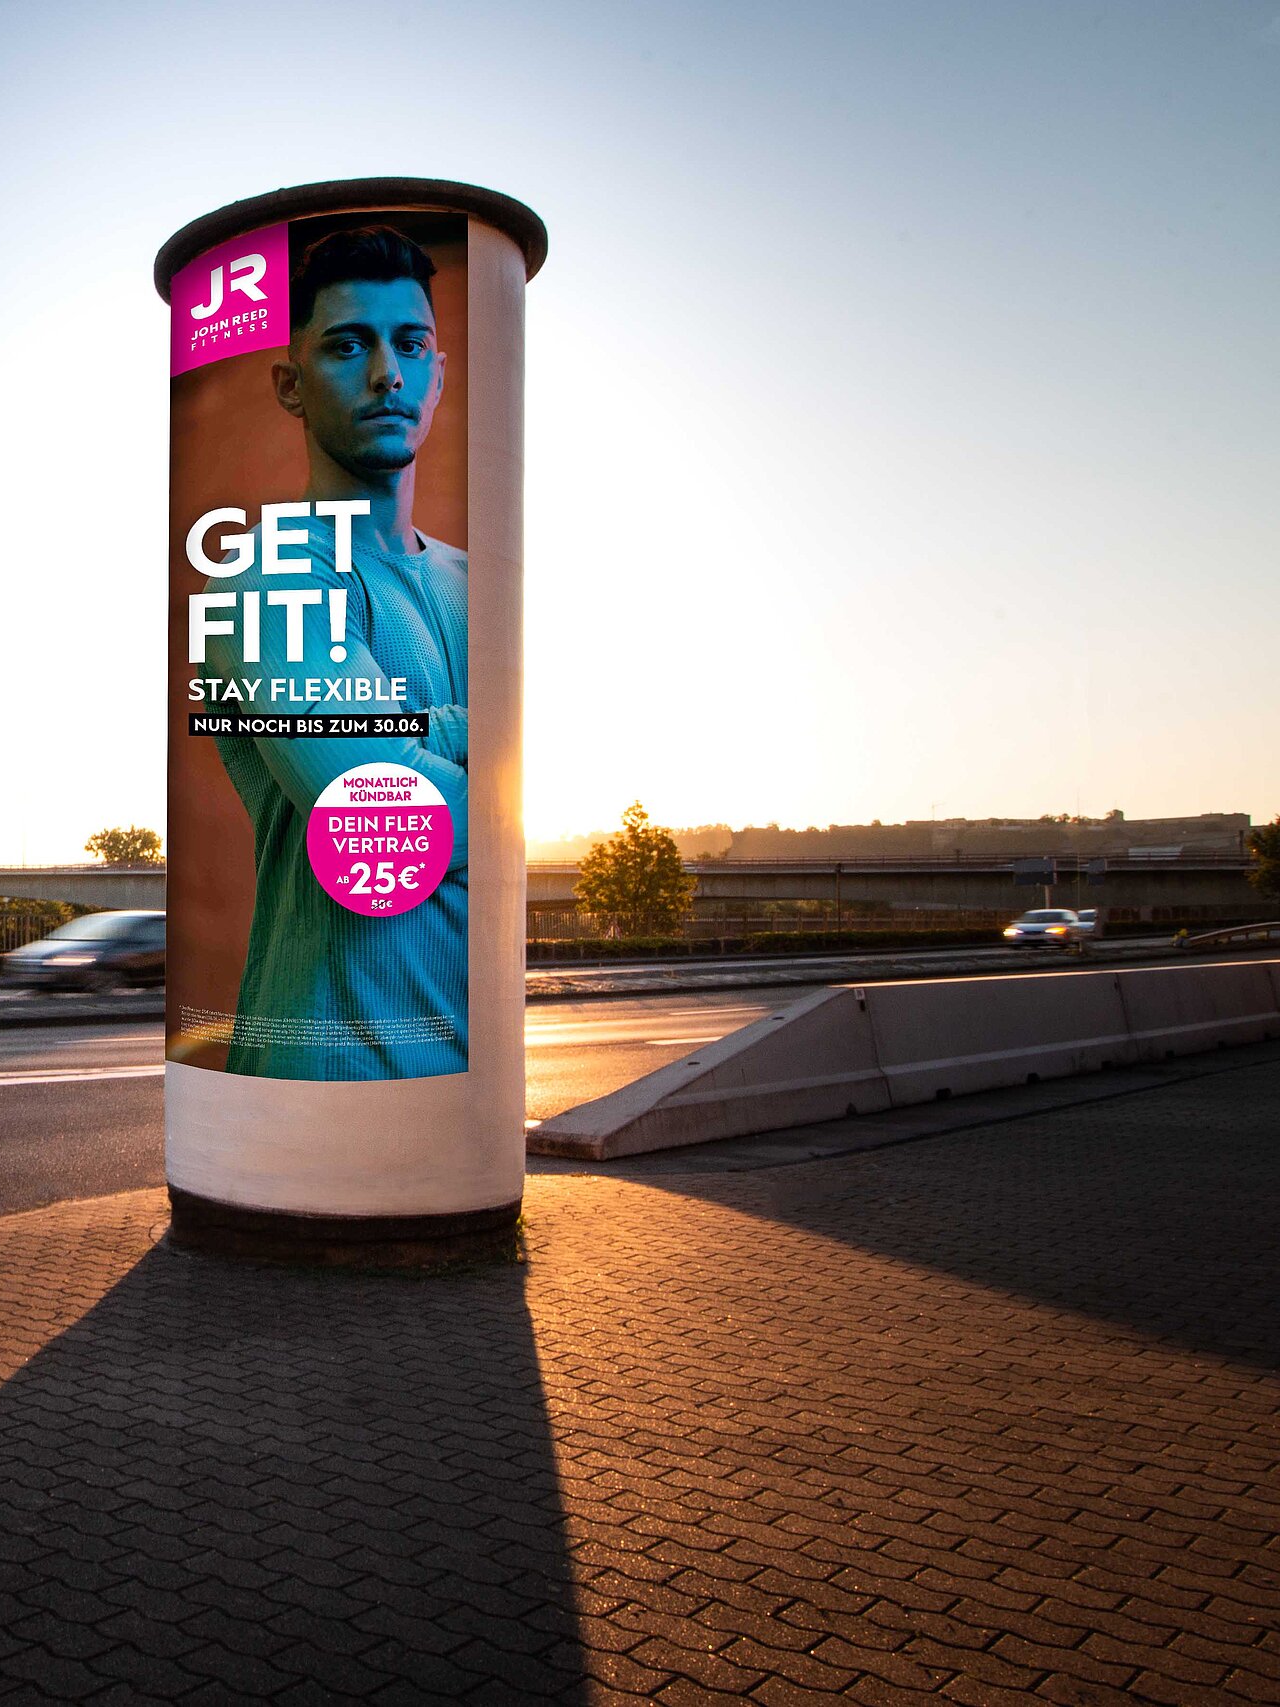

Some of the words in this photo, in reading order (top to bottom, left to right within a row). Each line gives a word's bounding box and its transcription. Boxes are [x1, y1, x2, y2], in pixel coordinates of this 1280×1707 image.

[191, 319, 228, 341] JOHN
[232, 309, 268, 326] REED
[186, 500, 370, 578] GET
[189, 589, 347, 663] FIT!
[188, 678, 262, 701] STAY
[270, 678, 407, 702] FLEXIBLE
[194, 719, 232, 732] NUR
[239, 719, 291, 732] NOCH
[296, 720, 323, 732] BIS
[330, 720, 368, 732] ZUM
[374, 719, 424, 732] 30.06.
[344, 777, 417, 788] MONATLICH
[350, 790, 411, 802] KÜNDBAR
[328, 816, 379, 832] DEIN
[385, 815, 432, 831] FLEX
[332, 836, 429, 853] VERTRAG
[336, 876, 349, 884] AB
